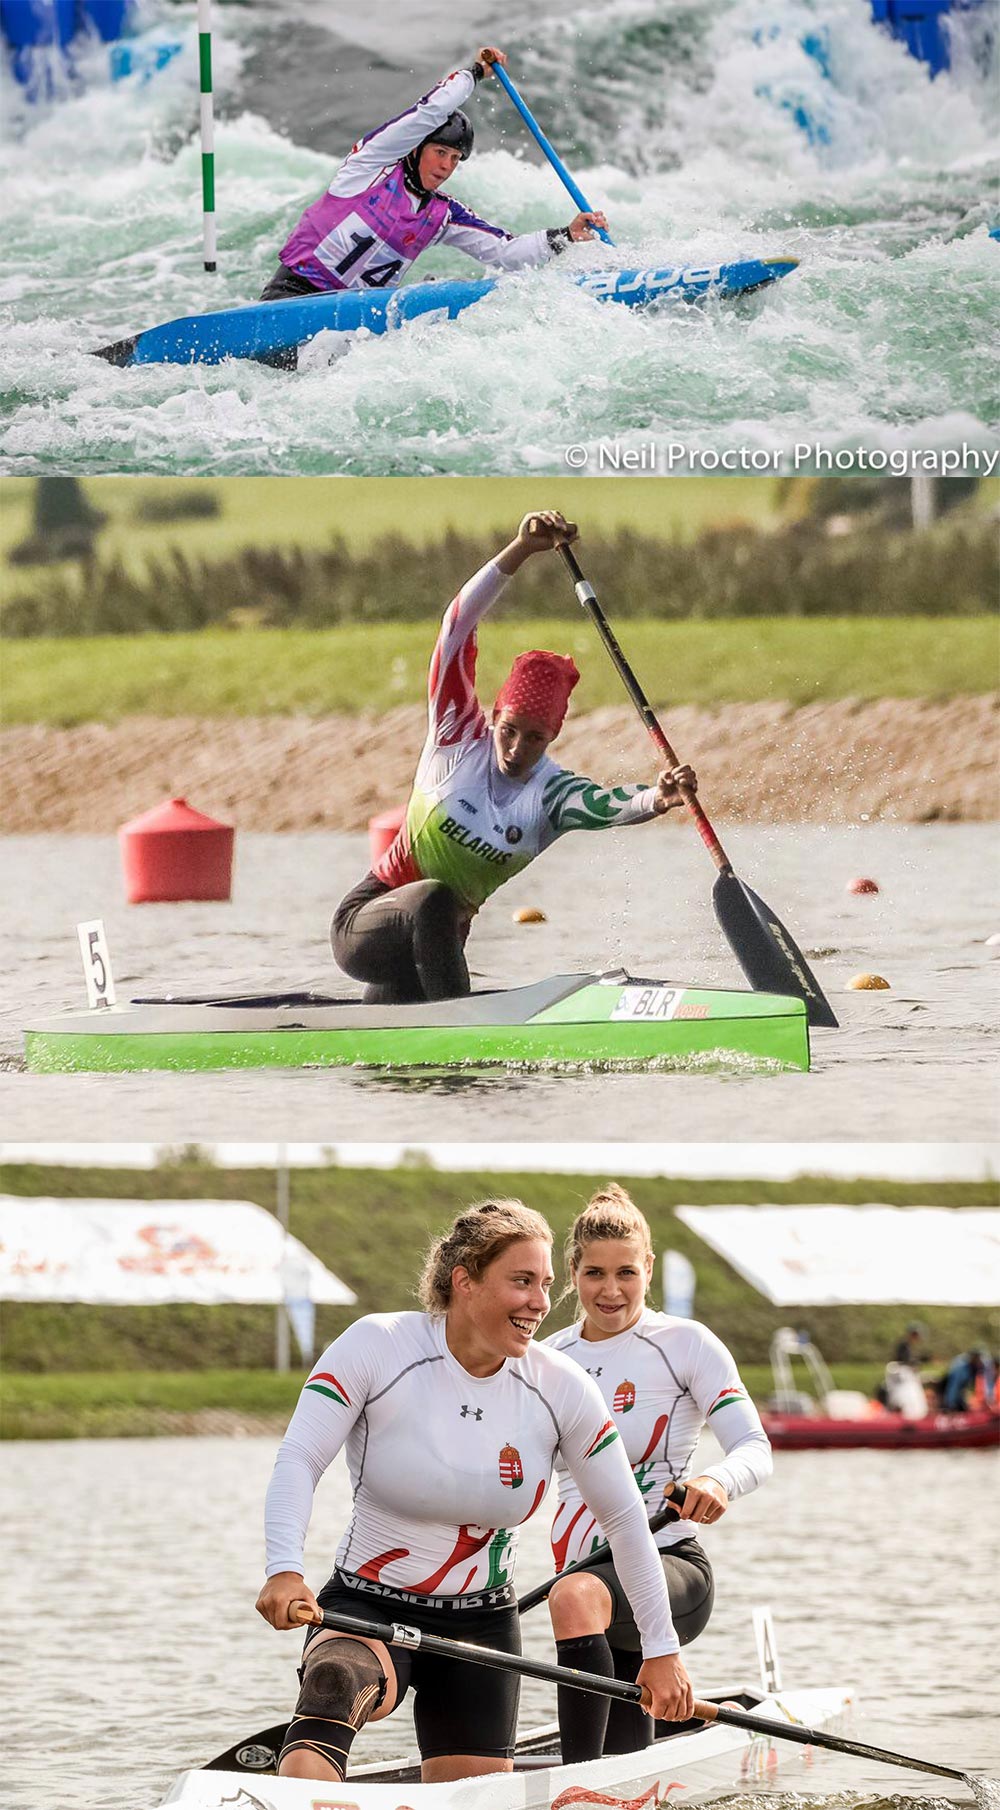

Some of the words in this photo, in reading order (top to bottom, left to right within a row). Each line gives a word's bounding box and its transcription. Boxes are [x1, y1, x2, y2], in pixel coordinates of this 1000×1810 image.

[335, 232, 404, 287] 14
[439, 817, 512, 865] BELARUS
[88, 931, 107, 994] 5
[632, 990, 676, 1017] BLR
